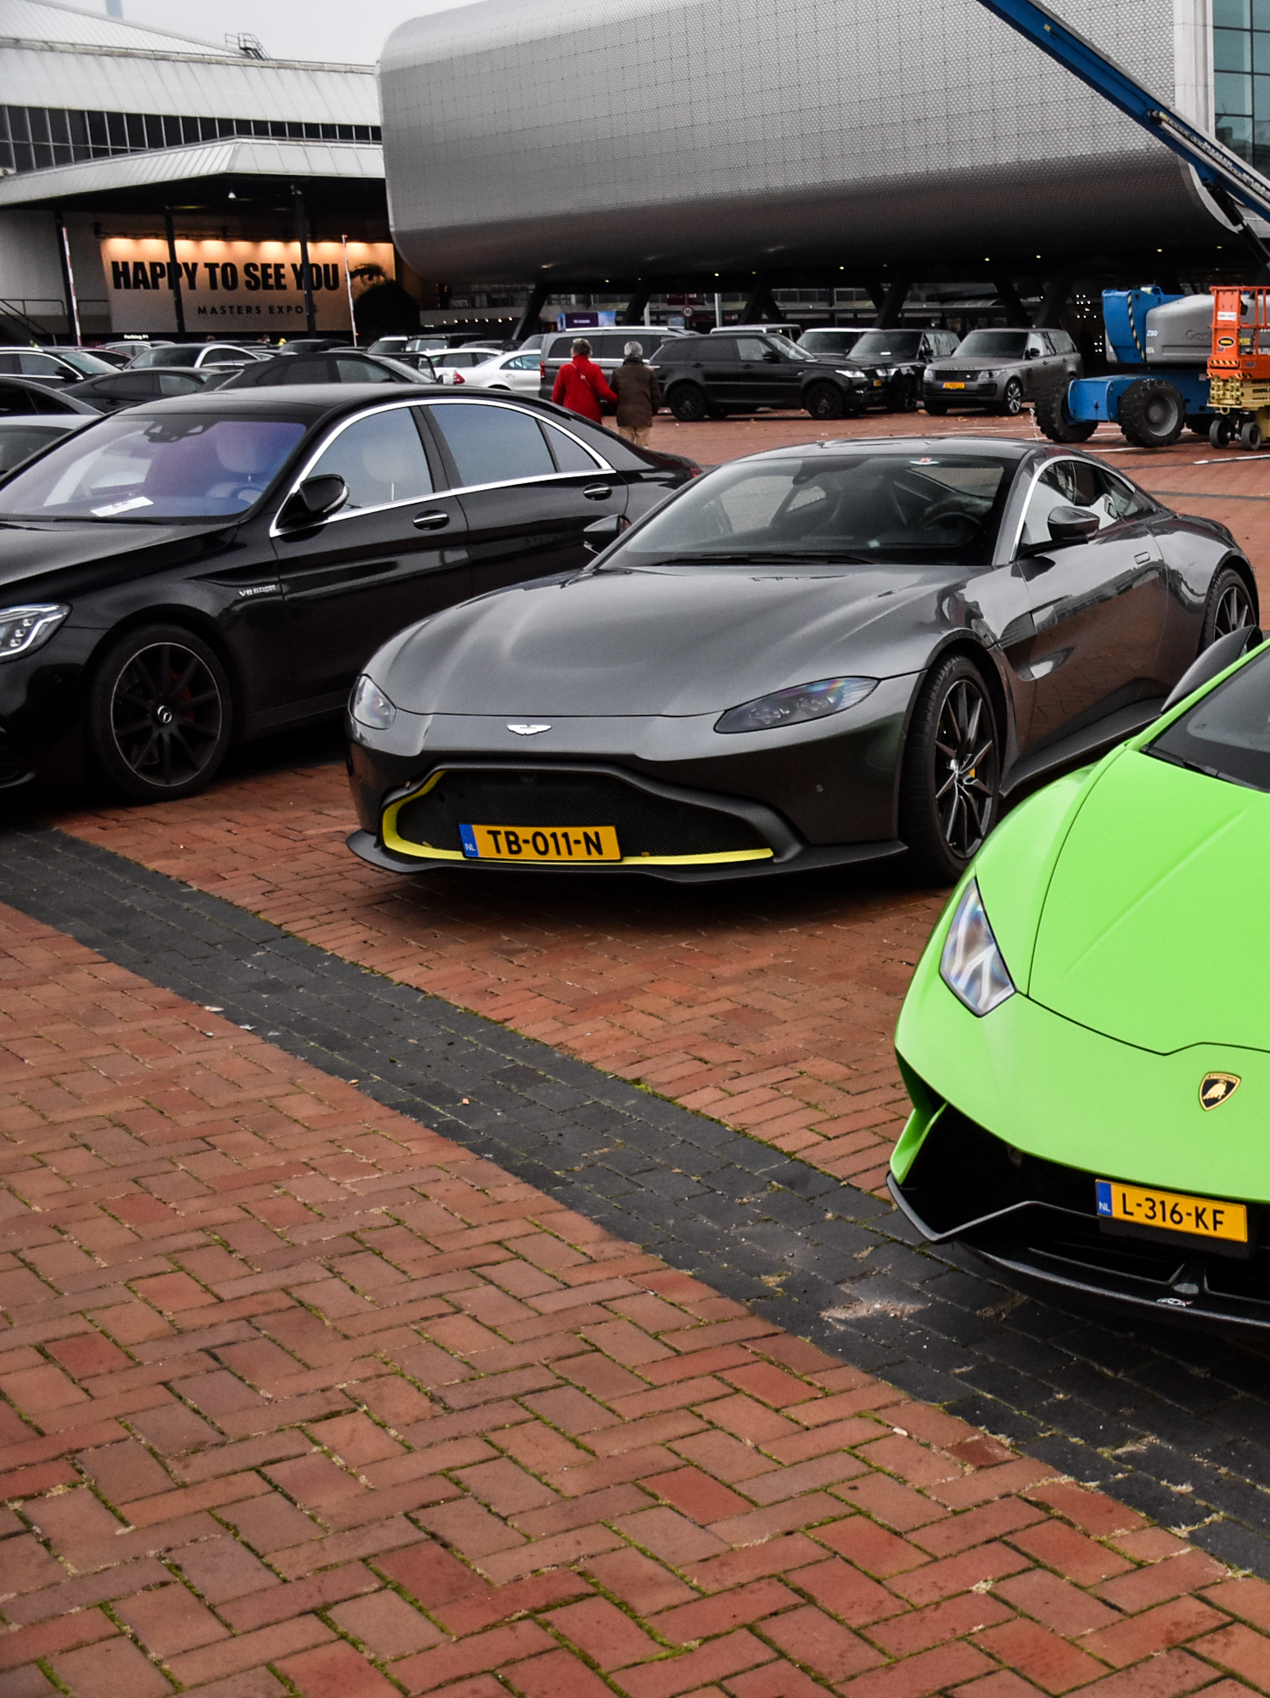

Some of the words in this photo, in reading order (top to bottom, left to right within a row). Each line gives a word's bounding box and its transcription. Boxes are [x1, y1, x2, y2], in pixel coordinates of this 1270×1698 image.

[111, 261, 199, 291] HAPPY
[204, 262, 239, 291] TO
[244, 263, 286, 291] SEE
[291, 263, 340, 291] YOU
[198, 305, 262, 315] MASTERS
[465, 843, 476, 852] NL
[486, 830, 604, 856] TB-011-N
[1098, 1201, 1111, 1213] NL
[1122, 1192, 1225, 1232] L-316-KF
